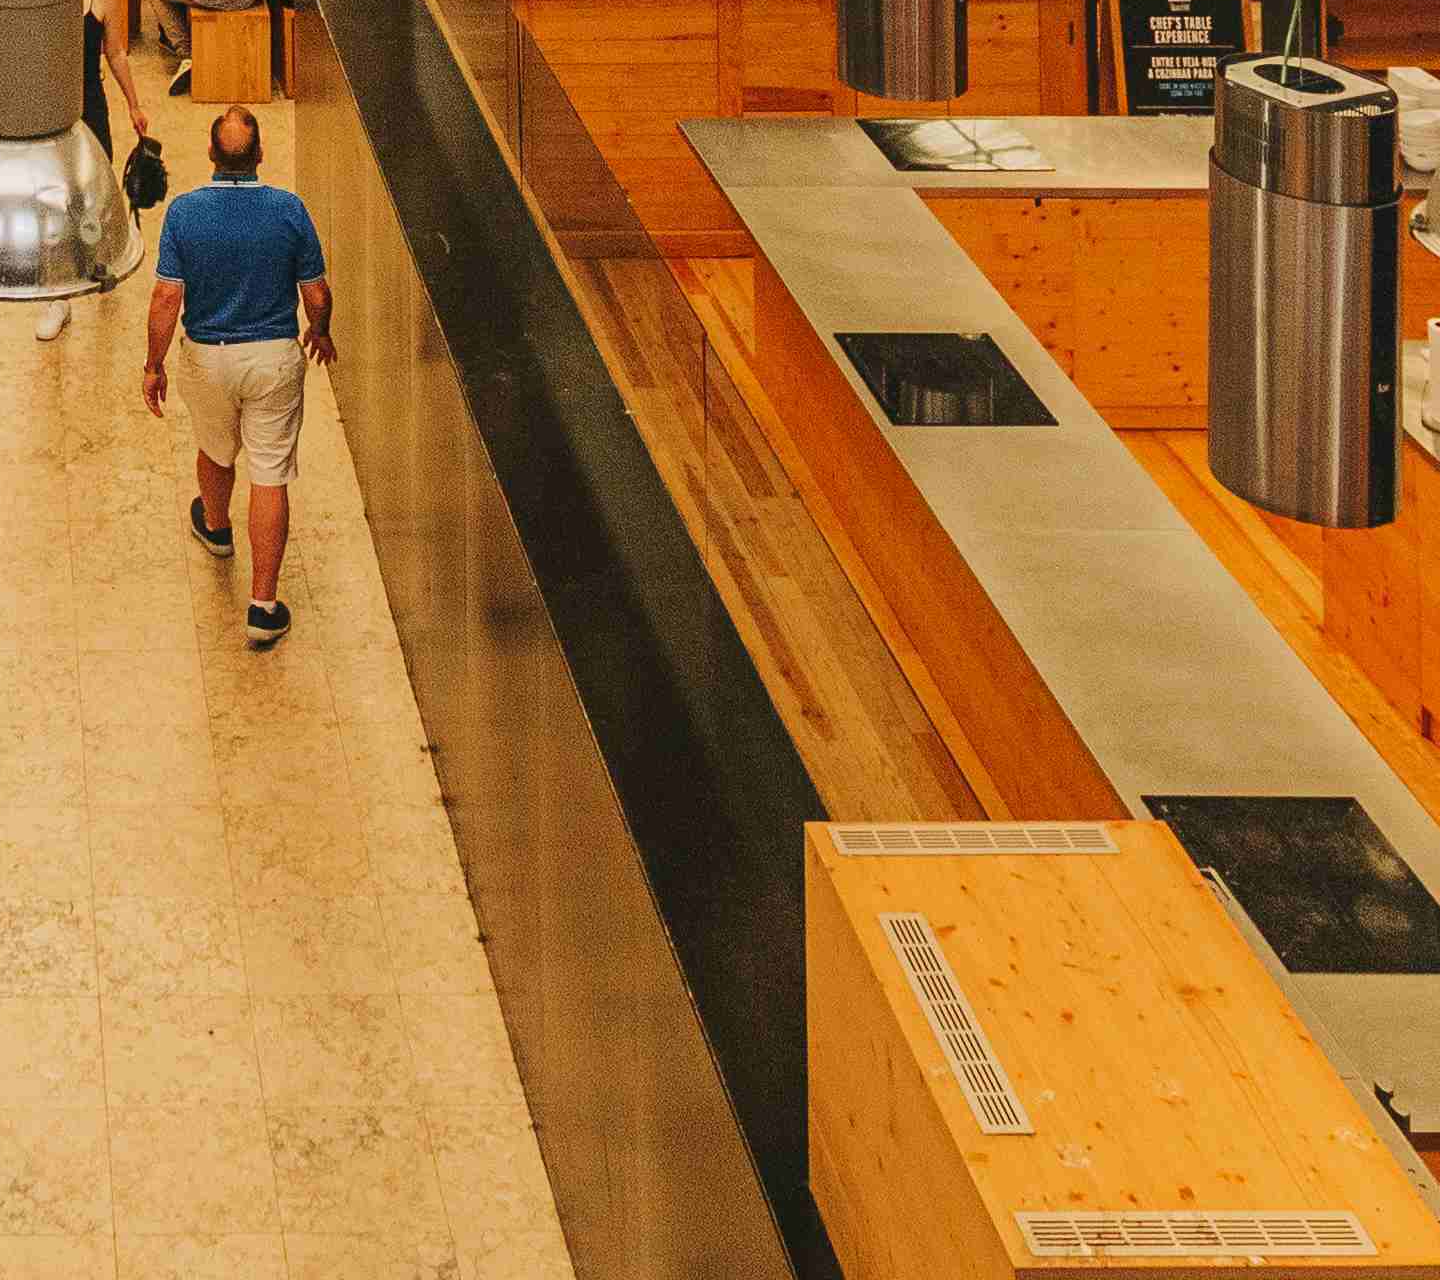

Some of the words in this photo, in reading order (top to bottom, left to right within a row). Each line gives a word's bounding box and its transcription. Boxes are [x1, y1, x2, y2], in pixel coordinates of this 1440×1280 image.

[1149, 15, 1182, 30] CHEF'S
[1183, 16, 1214, 30] TABLE
[1154, 30, 1211, 44] EXPERIENCE
[1193, 68, 1214, 79] PARA
